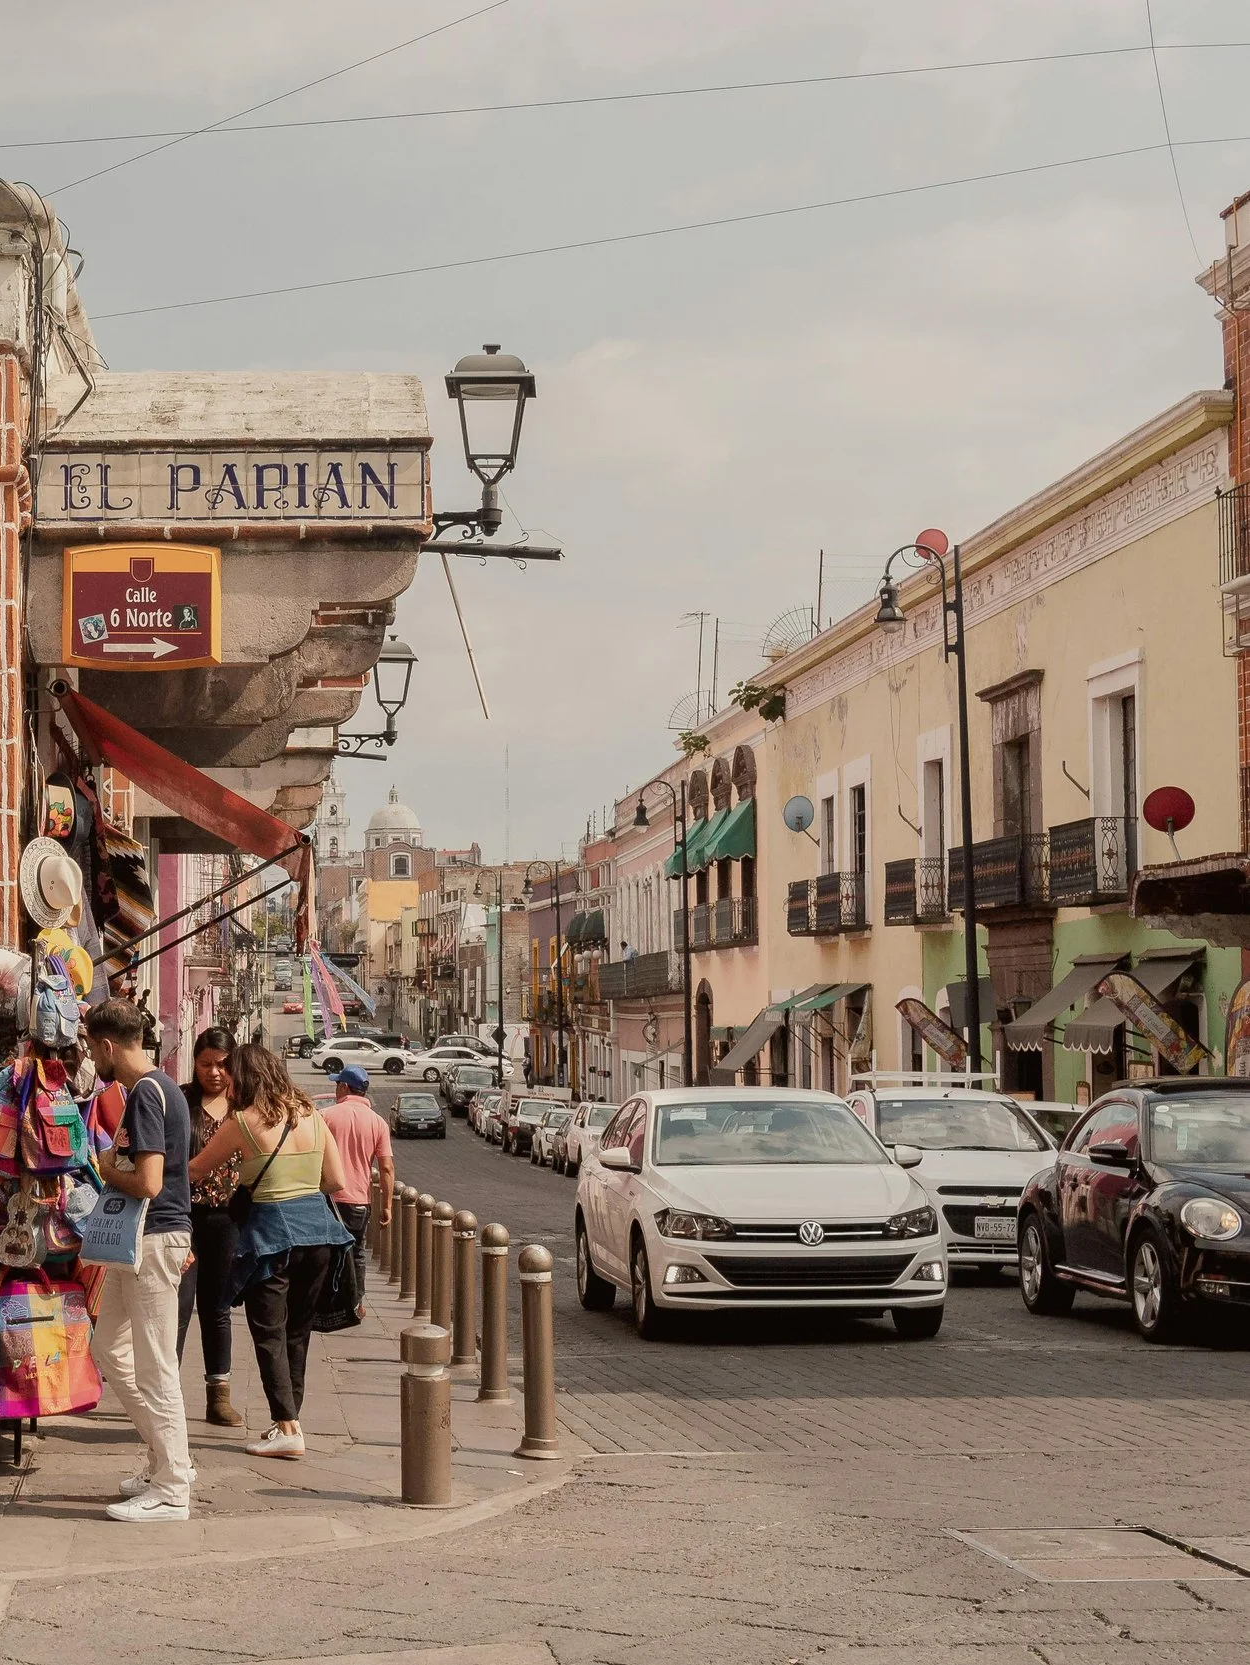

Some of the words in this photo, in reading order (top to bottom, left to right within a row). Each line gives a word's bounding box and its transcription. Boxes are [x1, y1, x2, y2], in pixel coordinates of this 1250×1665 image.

[60, 462, 134, 511] EL
[166, 461, 399, 511] PARIAN
[125, 587, 157, 604] Calle
[110, 608, 121, 628] 6
[126, 608, 173, 628] Norte
[87, 1230, 121, 1246] CHICAGO
